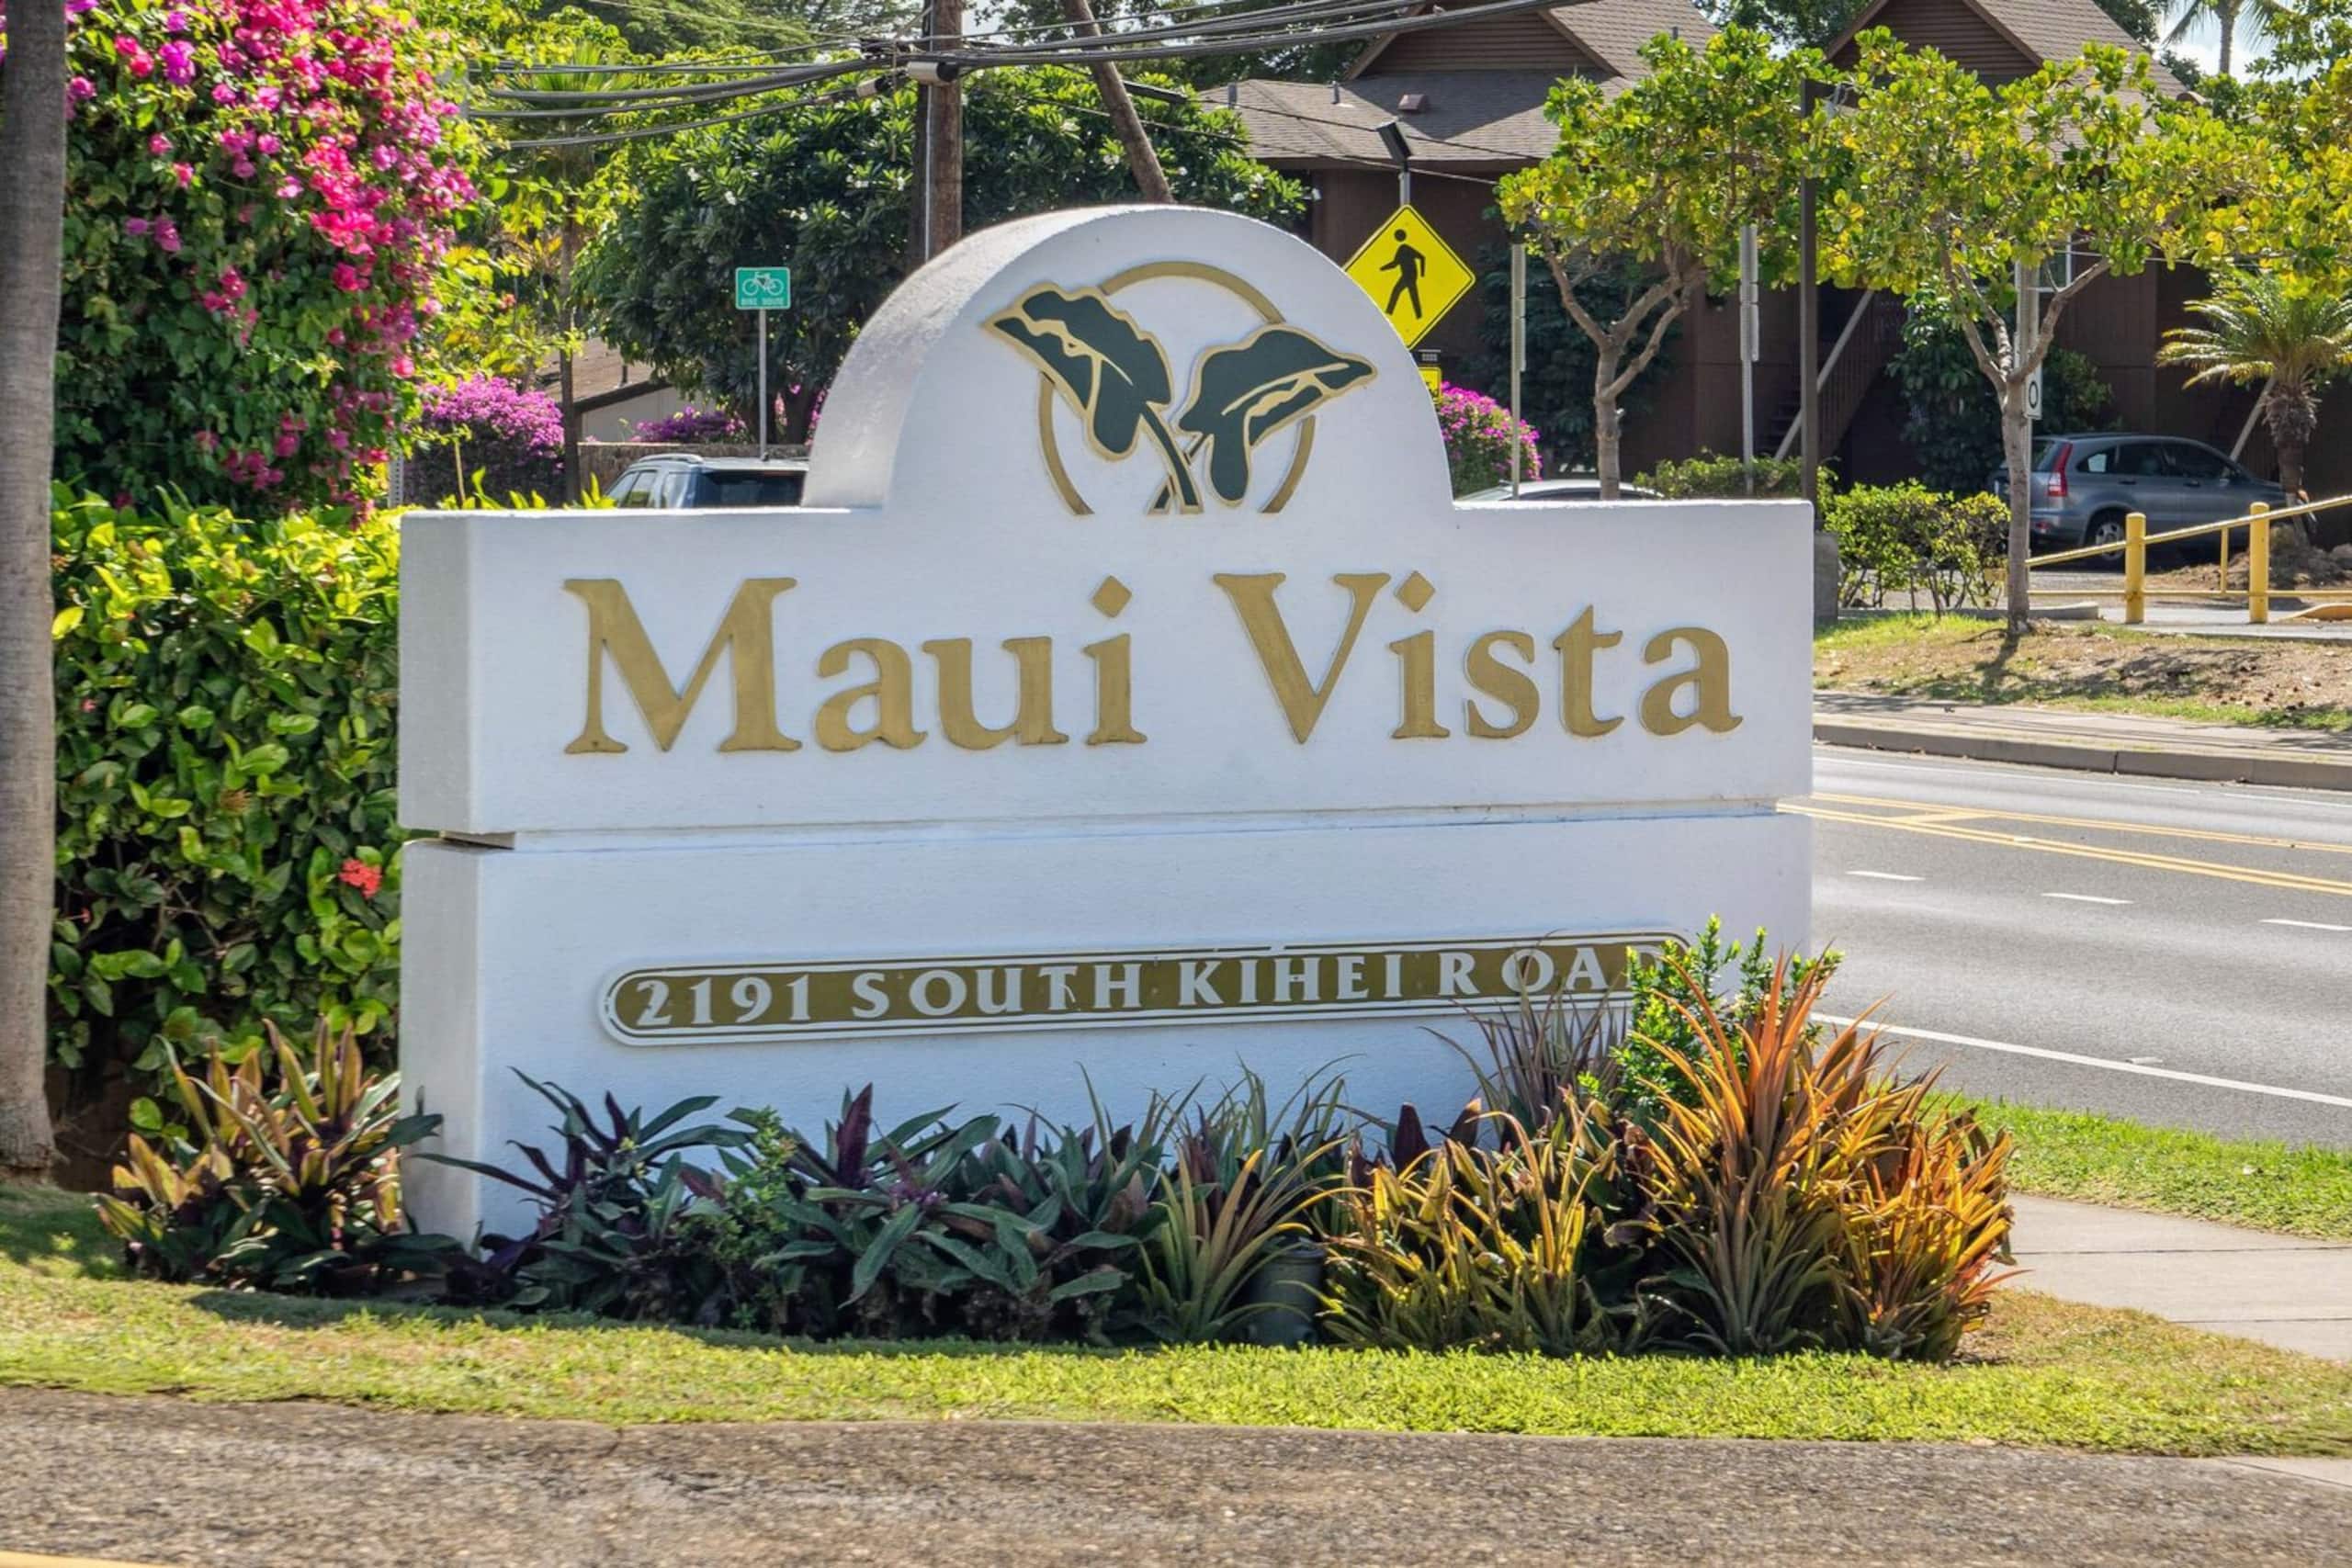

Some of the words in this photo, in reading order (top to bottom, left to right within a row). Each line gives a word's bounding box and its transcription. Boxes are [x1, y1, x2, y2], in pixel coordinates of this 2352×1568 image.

[560, 575, 1148, 754] Maui
[1213, 570, 1744, 745] Vista
[636, 975, 811, 1026] 2191
[852, 963, 1143, 1019] SOUTH
[1179, 953, 1405, 1007] KIHEI
